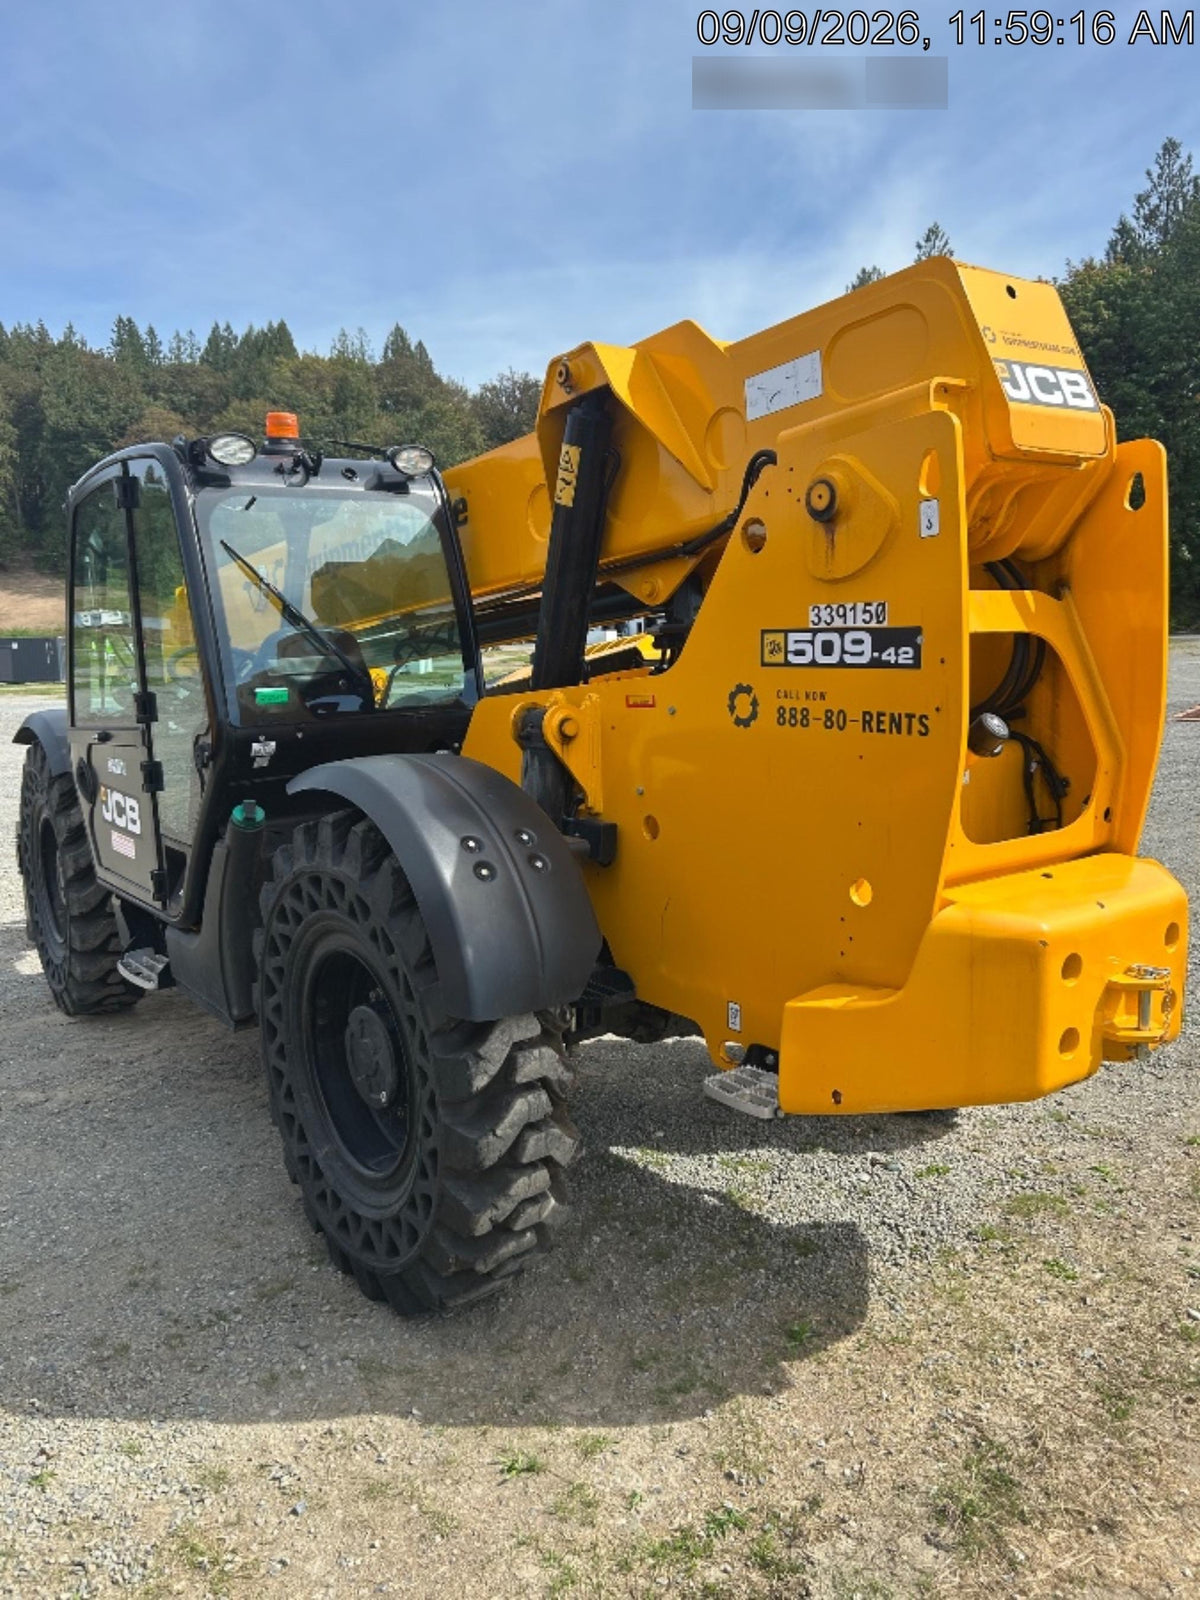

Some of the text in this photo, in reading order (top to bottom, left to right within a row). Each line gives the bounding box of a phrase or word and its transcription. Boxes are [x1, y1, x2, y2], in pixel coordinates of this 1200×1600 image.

[1002, 363, 1095, 408] JCB
[810, 601, 887, 627] 339150
[786, 630, 915, 664] 509-42
[776, 689, 828, 702] CALL NOW
[775, 705, 931, 738] 888-80-RENTS
[101, 787, 142, 835] JCB
